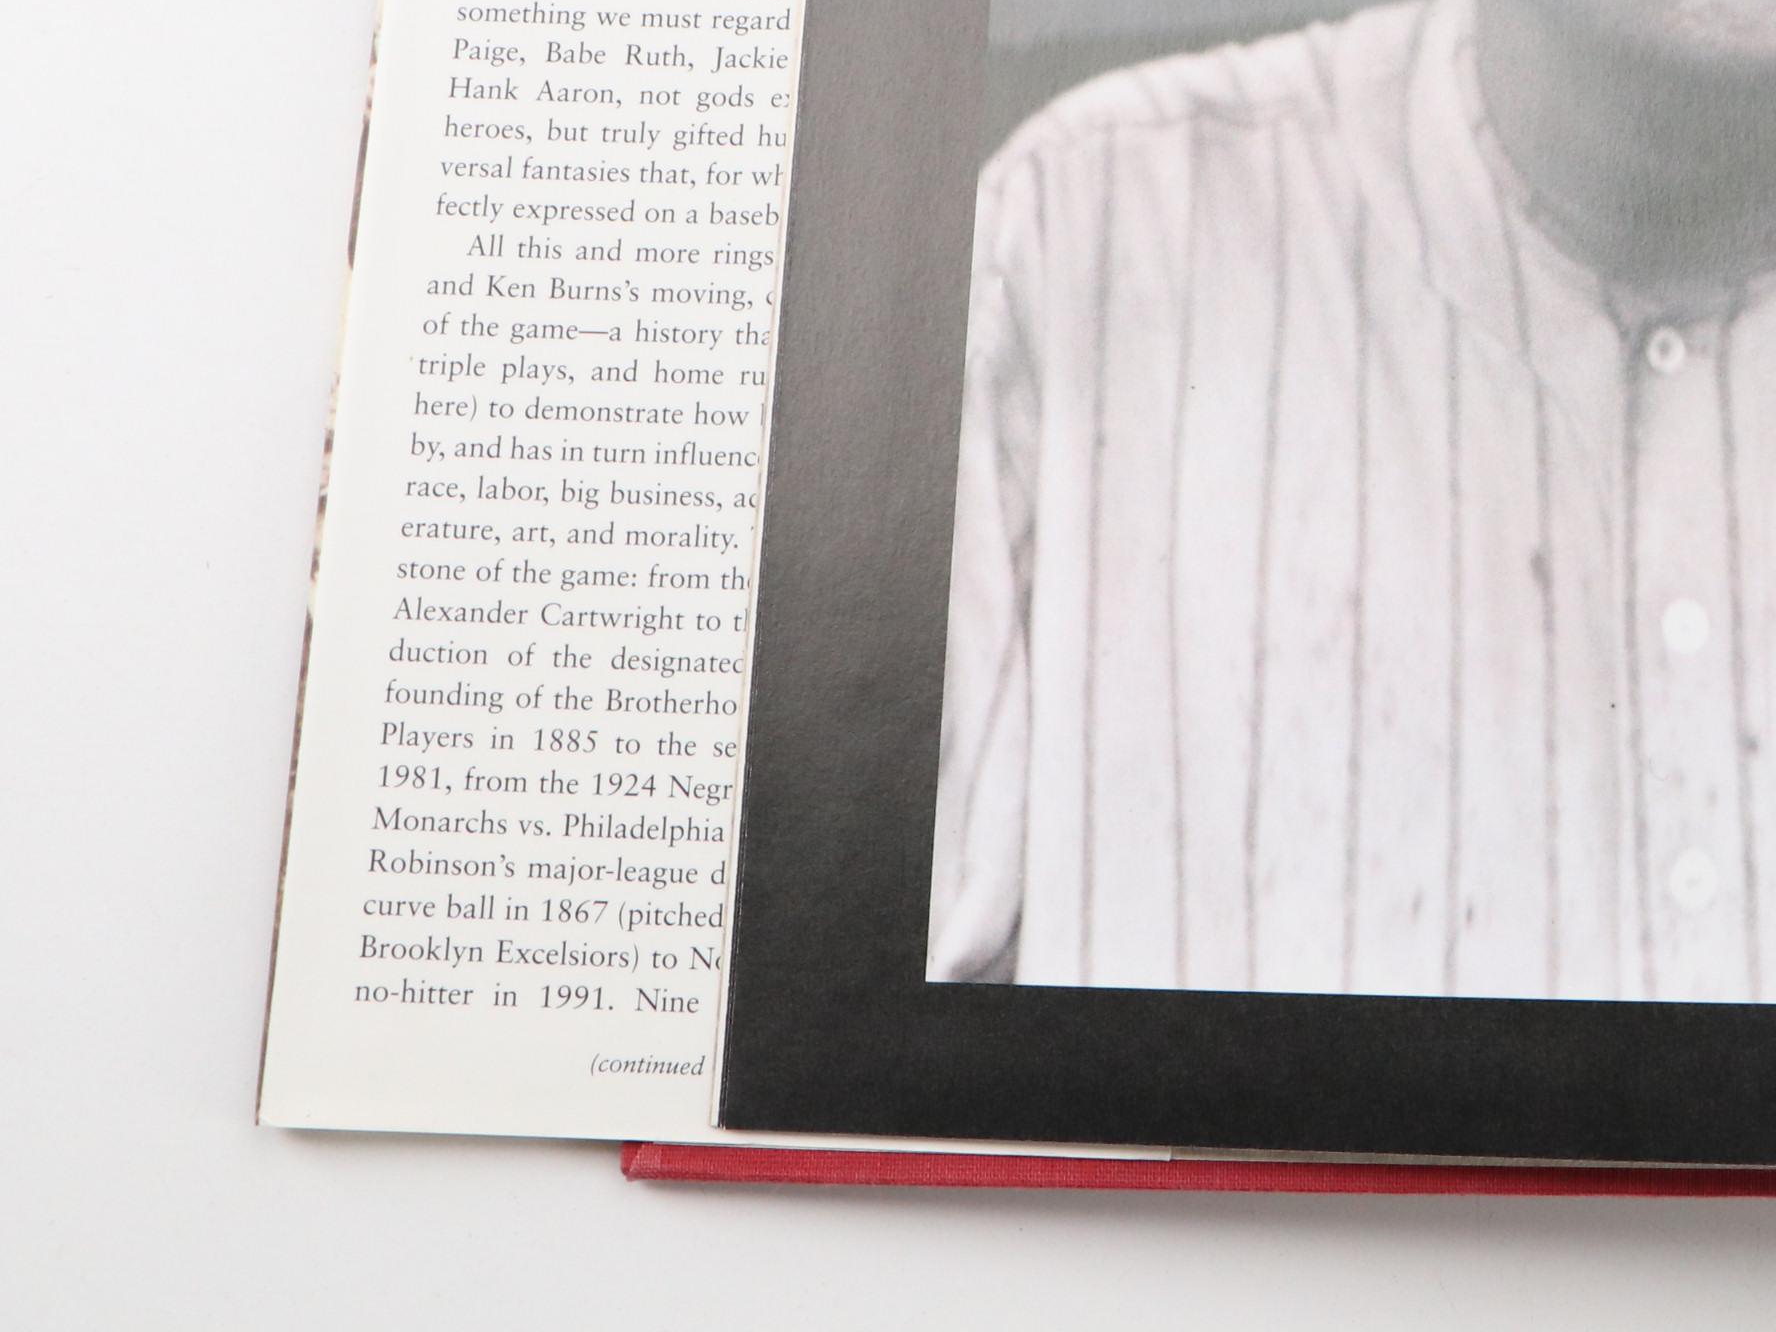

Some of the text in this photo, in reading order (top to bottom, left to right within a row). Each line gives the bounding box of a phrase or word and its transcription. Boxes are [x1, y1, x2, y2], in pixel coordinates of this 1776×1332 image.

[457, 1, 790, 36] something we must regard
[454, 38, 788, 73] Paige, Babe Ruth, Jackie
[449, 77, 754, 112] Hank Aaron, not gods
[445, 114, 744, 151] heroes, but truly gifted
[441, 156, 742, 188] versal fantasies that, for
[437, 192, 504, 223] fectly
[513, 199, 635, 226] expressed
[645, 208, 675, 223] on
[467, 234, 773, 271] All this more rings
[486, 275, 535, 298] Ken
[652, 282, 752, 311] moving,
[461, 313, 499, 337] the
[635, 319, 723, 350] history
[420, 353, 724, 385] triple plays, home
[415, 392, 477, 421] here)
[525, 396, 683, 424] demonstrate
[695, 401, 749, 426] how
[411, 432, 760, 467] by, has turn influenc
[406, 475, 722, 511] race, labor, big business,
[401, 521, 738, 555] erature, art, and morality.
[397, 562, 709, 592] stone game: from
[393, 596, 685, 636] Alexander Cartwright
[389, 637, 487, 665] duction
[384, 679, 504, 714] founding
[516, 684, 544, 708] of
[380, 721, 598, 753] Players 1885
[380, 765, 451, 795] 1981,
[465, 766, 527, 792] from
[540, 769, 579, 795] the
[593, 773, 656, 797] 1924
[372, 807, 724, 848] Monarchs vs. Philadelphia
[528, 856, 698, 890] major-league
[363, 900, 435, 918] curve
[447, 893, 494, 920] ball
[543, 899, 608, 924] 1867
[360, 935, 639, 973] Brooklyn Excelsiors)
[355, 978, 699, 1014] no-hitter 1991. Nine
[591, 1053, 706, 1076] (continued
